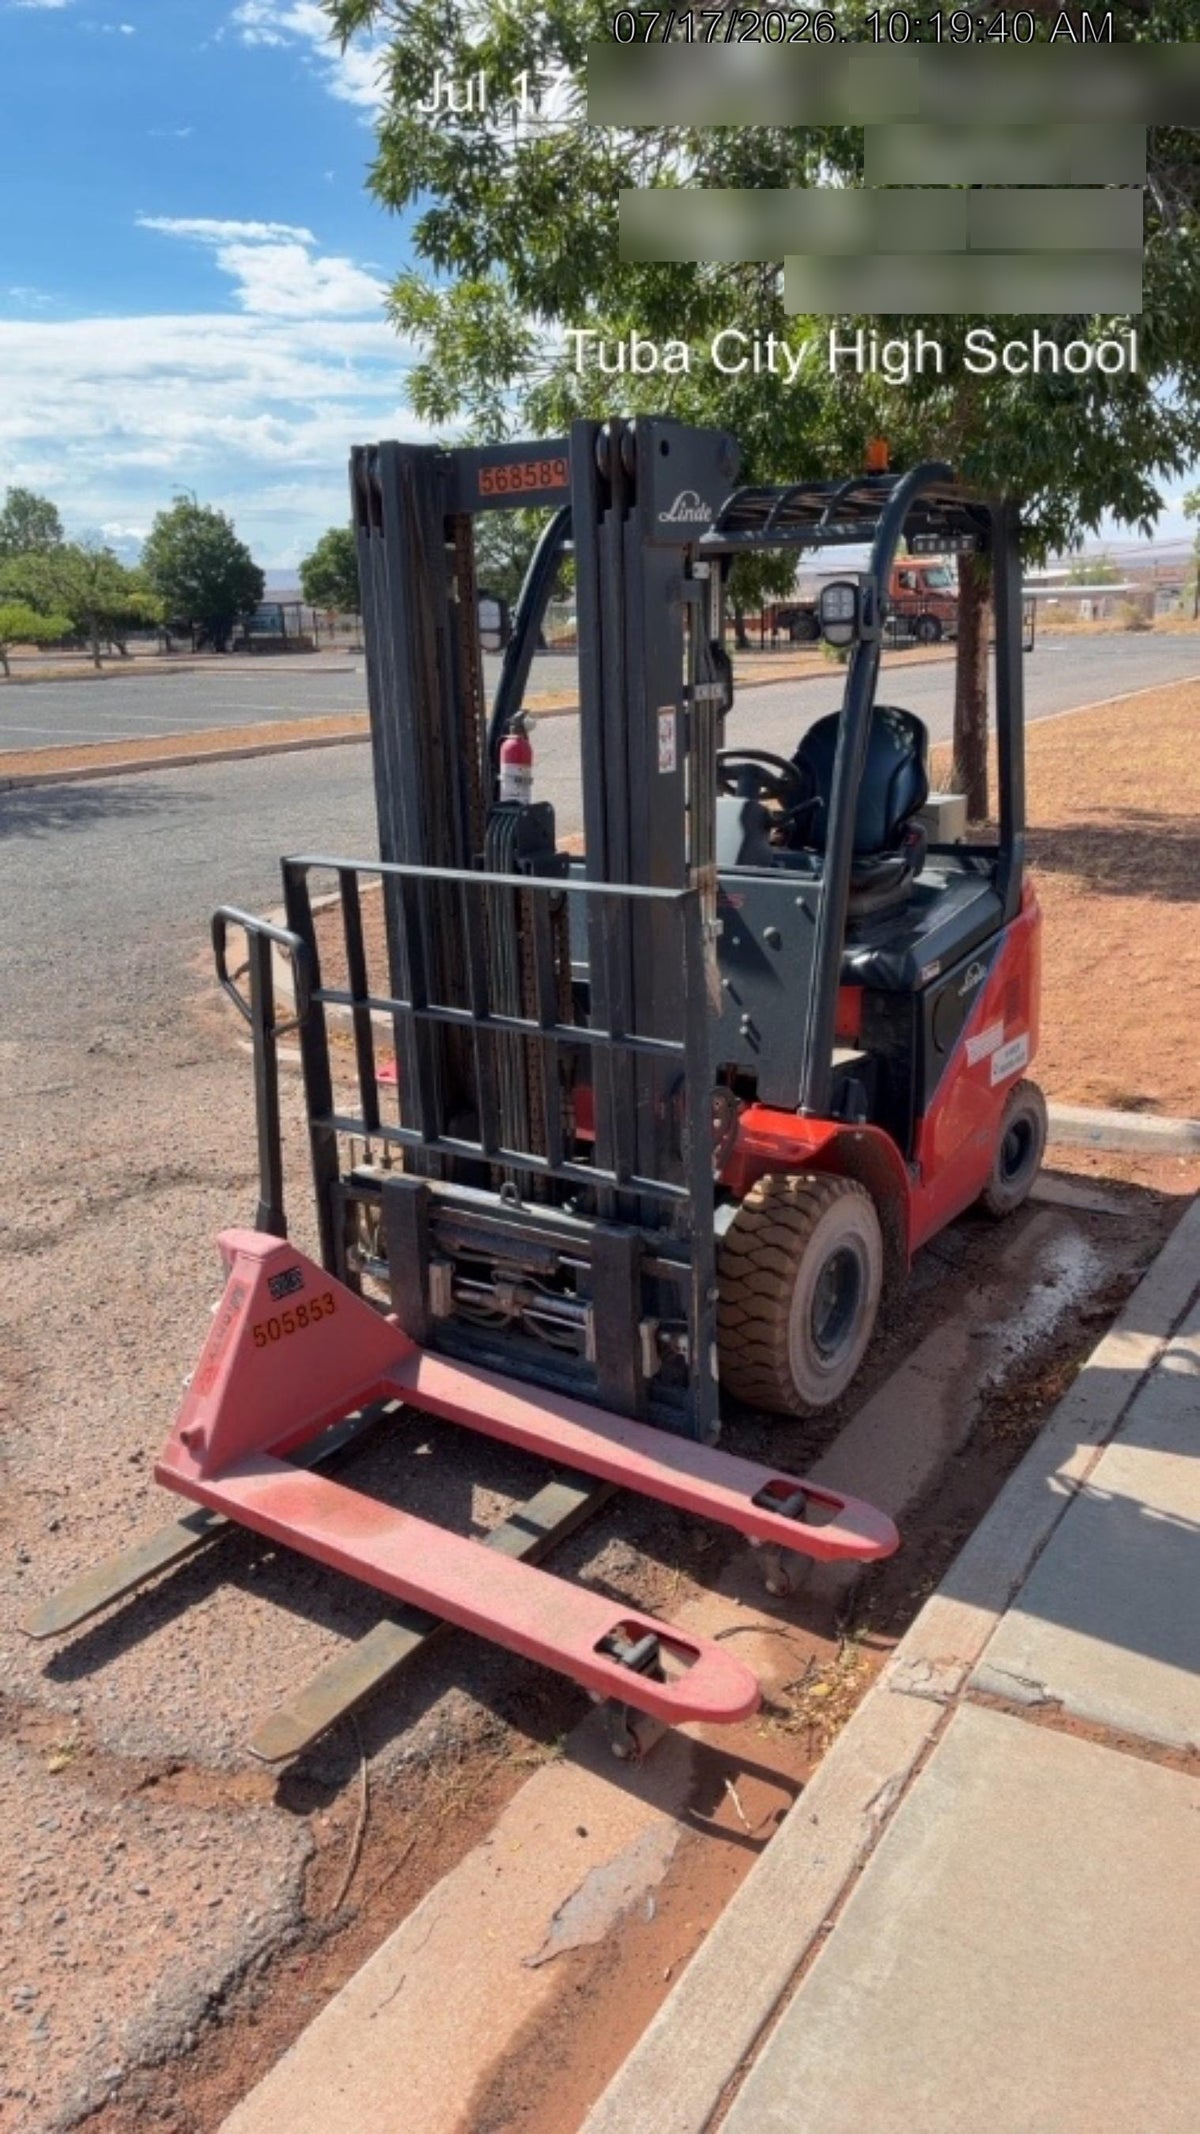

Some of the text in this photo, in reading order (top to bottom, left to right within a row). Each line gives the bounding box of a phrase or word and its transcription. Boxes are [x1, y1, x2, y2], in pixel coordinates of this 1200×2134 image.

[481, 459, 567, 493] 568589
[658, 490, 713, 522] Linde
[252, 1292, 336, 1348] 505853
